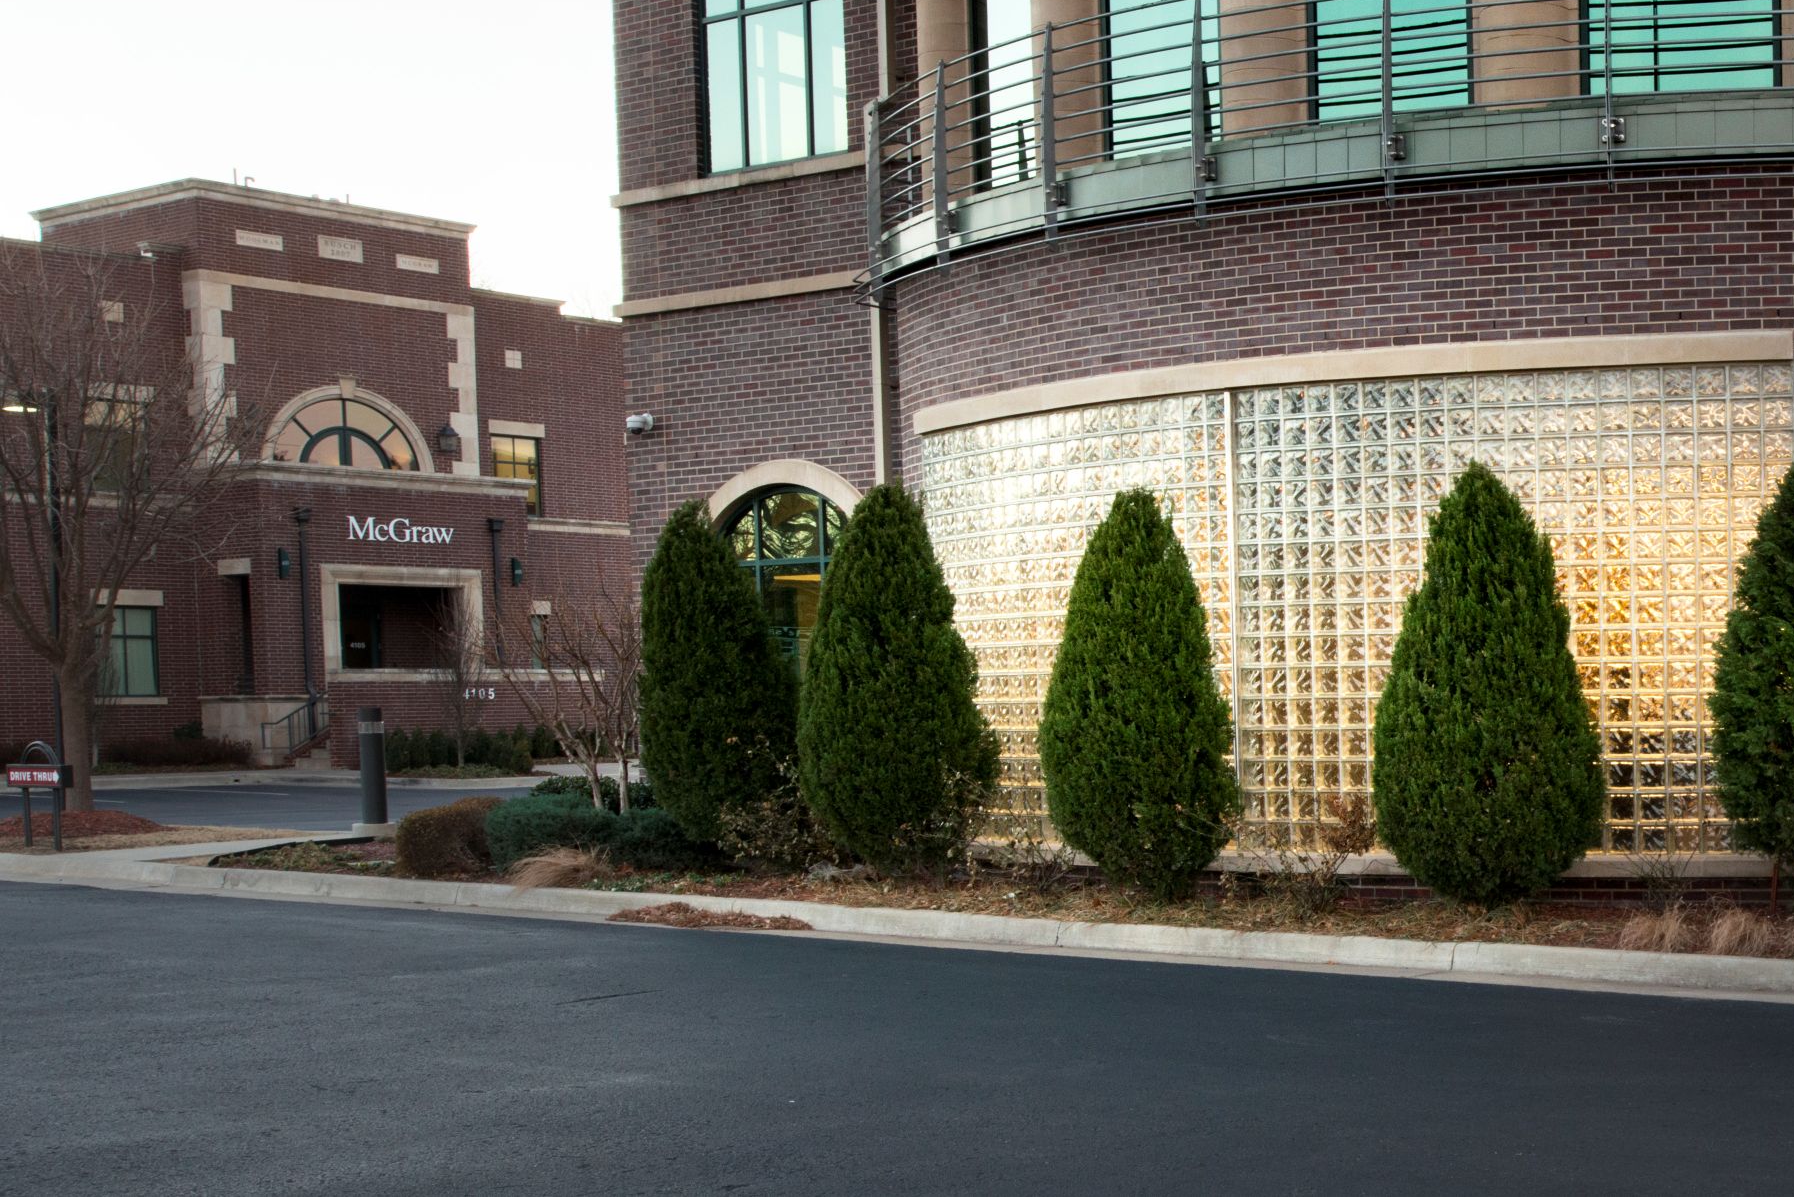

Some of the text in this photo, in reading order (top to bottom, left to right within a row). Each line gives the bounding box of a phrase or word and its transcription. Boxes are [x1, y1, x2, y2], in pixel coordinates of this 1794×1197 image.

[346, 515, 454, 544] McGraw
[10, 771, 53, 782] DRIVE THRU
